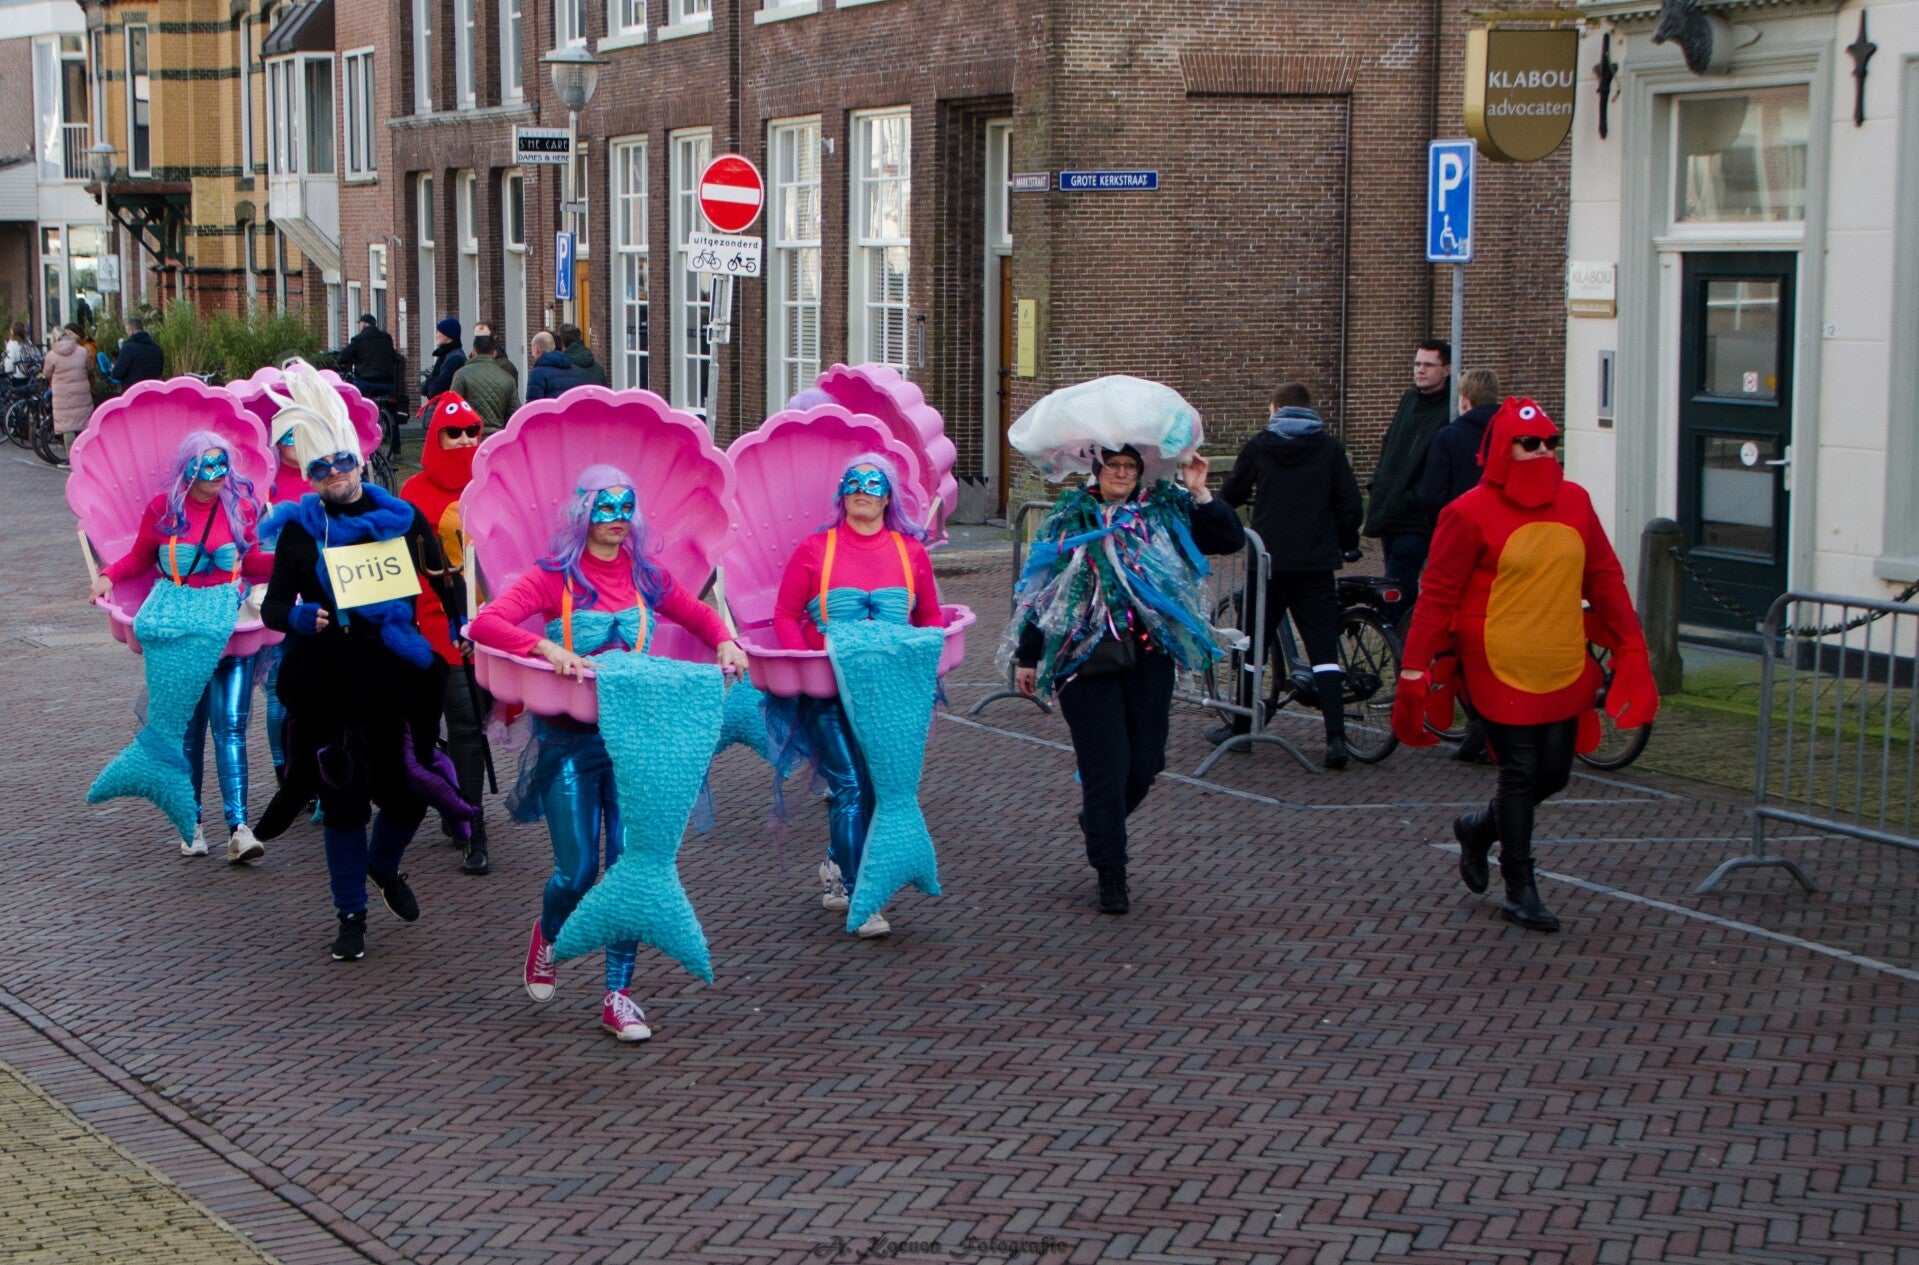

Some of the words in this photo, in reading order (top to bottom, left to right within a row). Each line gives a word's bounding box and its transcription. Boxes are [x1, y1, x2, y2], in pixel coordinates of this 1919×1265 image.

[1488, 70, 1574, 88] KLABOU
[1486, 99, 1572, 117] advocaten
[519, 129, 569, 137] hairstudi
[545, 140, 568, 151] CARE
[518, 154, 542, 162] DAMES
[1071, 175, 1097, 187] GROTE
[1100, 174, 1148, 187] KERKSTRAAT
[1438, 153, 1463, 212] P
[694, 237, 758, 249] uitgezonderd
[560, 238, 568, 270] P
[335, 556, 402, 593] prijs
